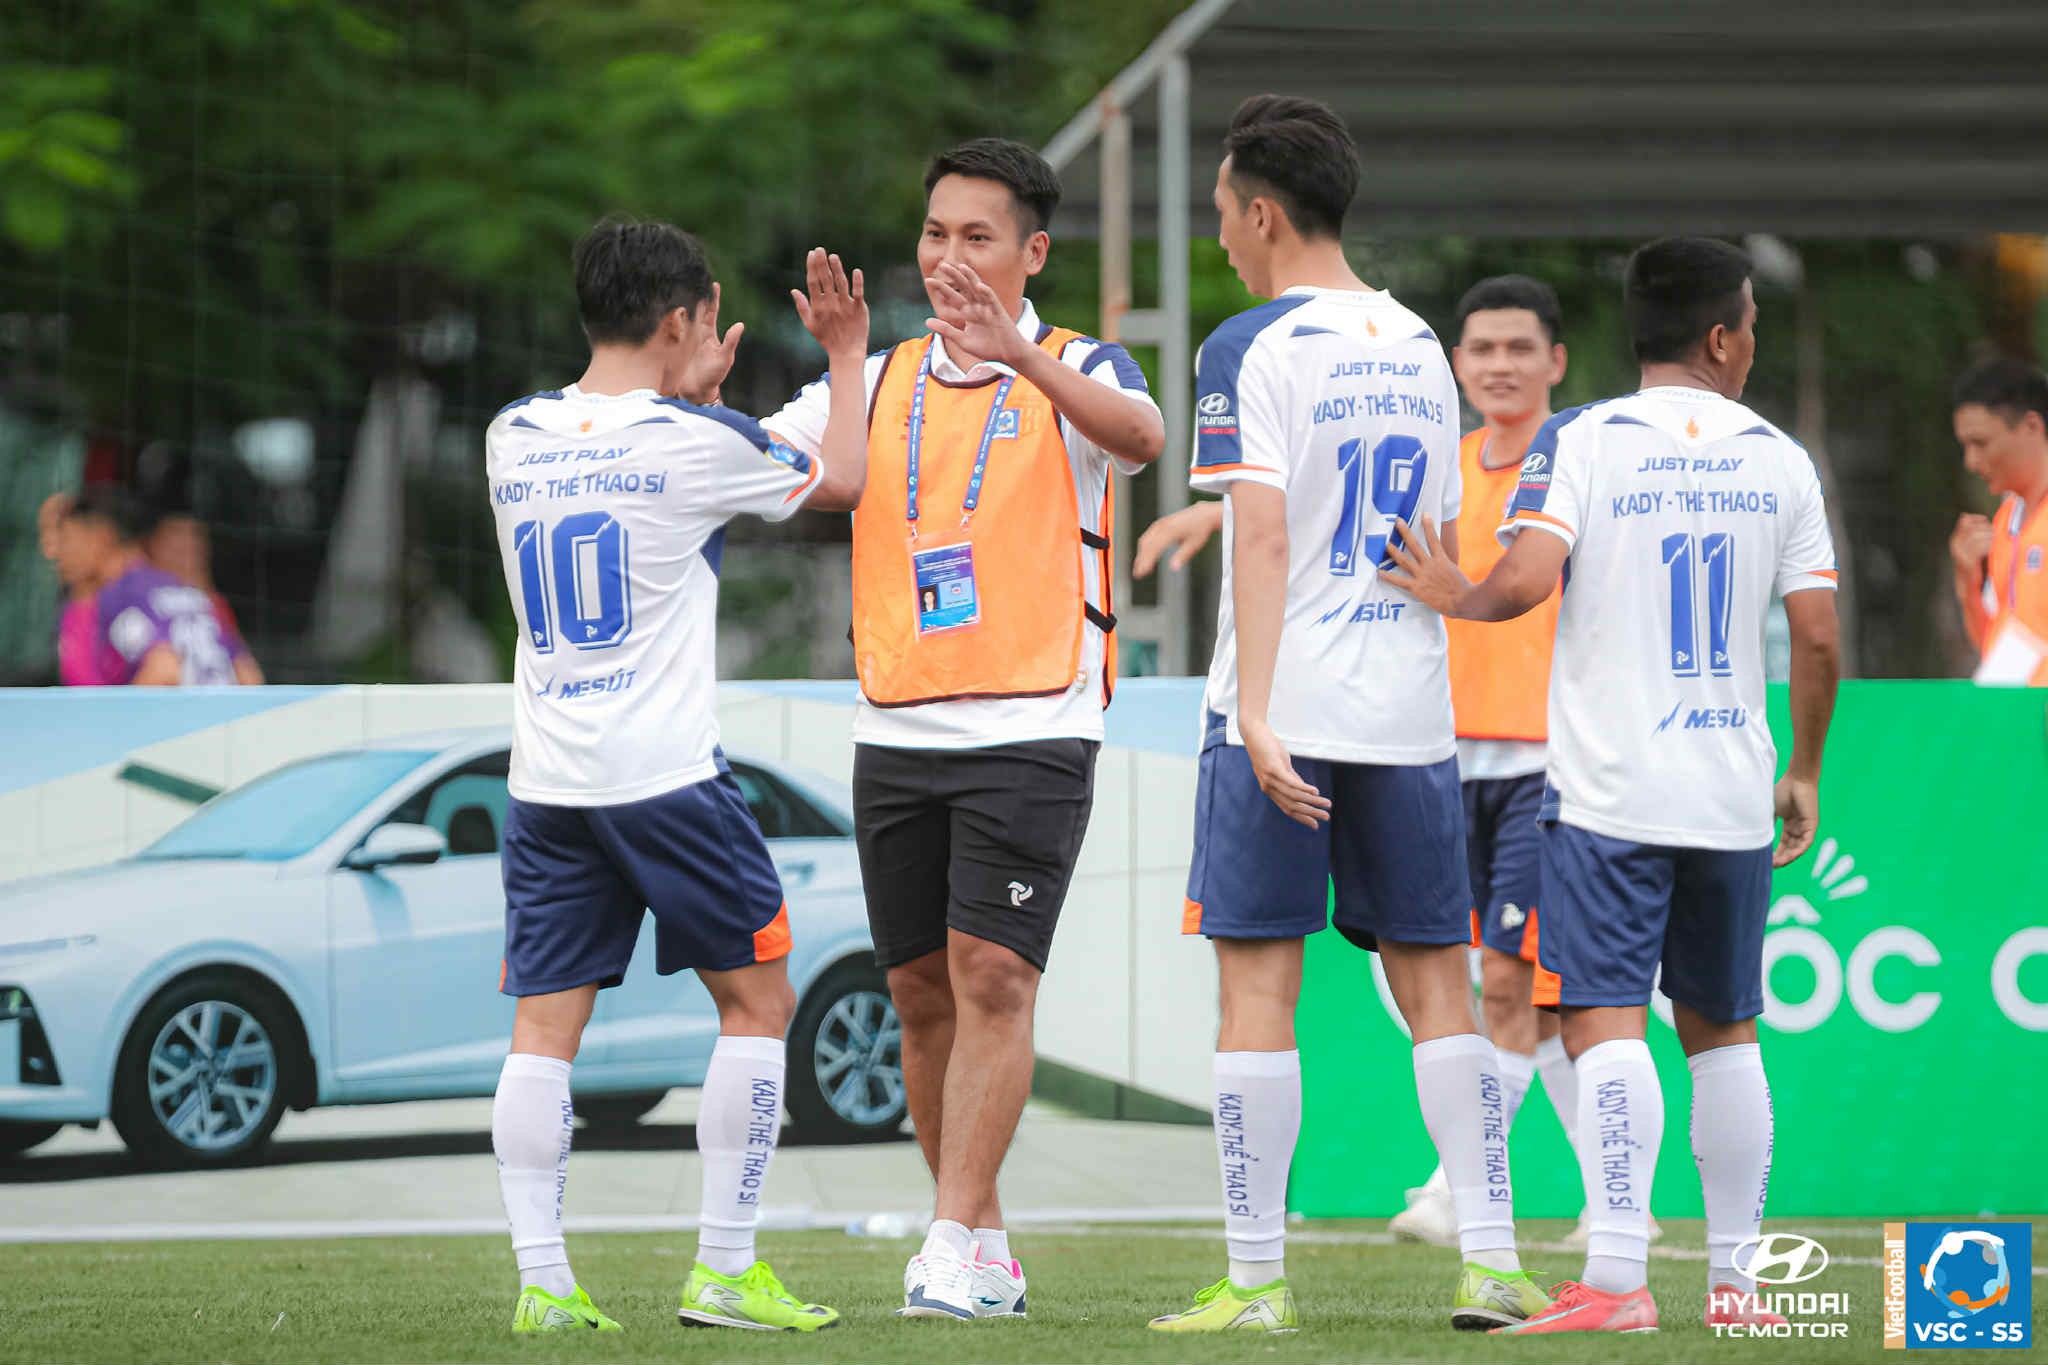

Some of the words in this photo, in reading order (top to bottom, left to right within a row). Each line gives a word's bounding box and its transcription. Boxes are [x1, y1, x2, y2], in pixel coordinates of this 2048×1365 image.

[1330, 362, 1375, 378] JUST
[1378, 362, 1422, 376] PLAY
[1313, 397, 1355, 425] KADY
[517, 450, 575, 467] JUST
[575, 447, 633, 462] PLAY
[1637, 457, 1689, 473] JUST
[1692, 457, 1745, 473] PLAY
[495, 481, 533, 505] KADY
[583, 472, 641, 494] THAO
[1329, 434, 1428, 577] 19
[1612, 491, 1663, 518] KADY
[1707, 490, 1760, 513] THAO
[514, 510, 632, 655] 10
[1662, 532, 1735, 678] 11
[741, 1152, 768, 1189] THAO
[1225, 1163, 1248, 1201] THAO
[1485, 1147, 1507, 1184] THAO
[1602, 1151, 1631, 1193] THAO
